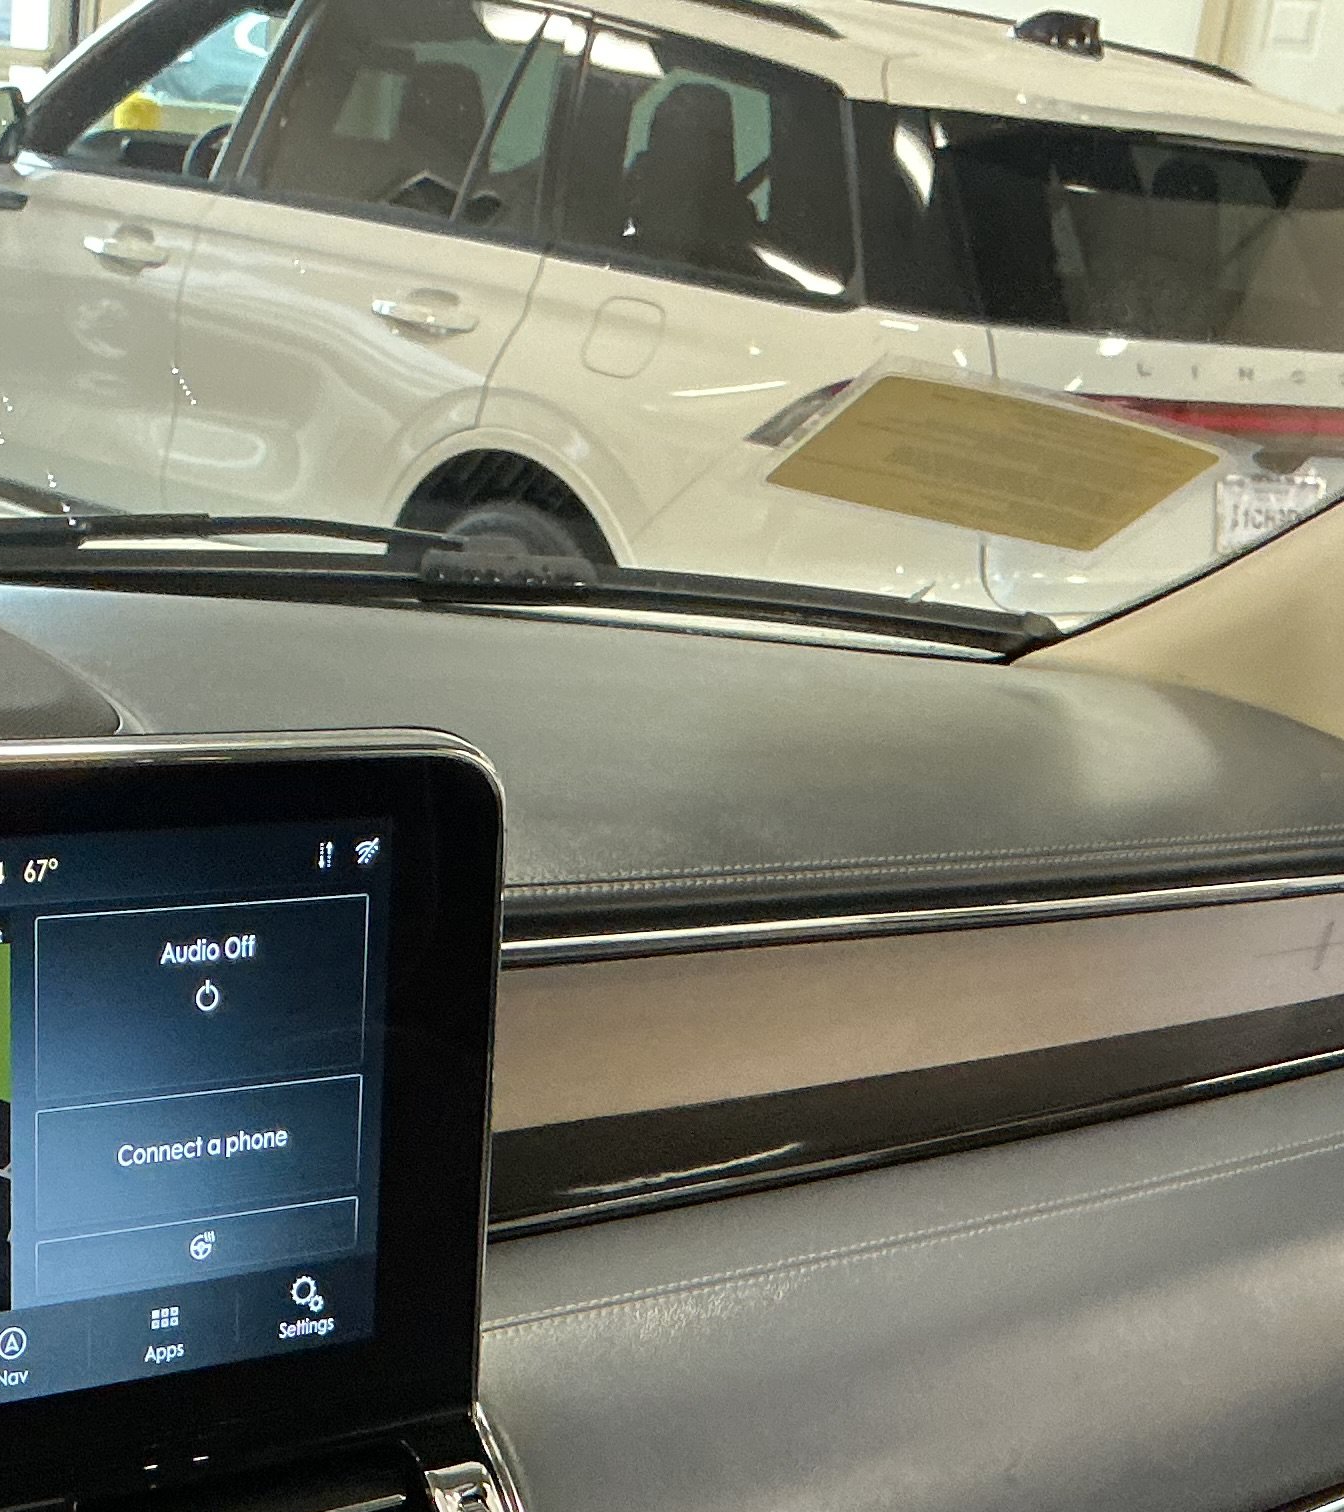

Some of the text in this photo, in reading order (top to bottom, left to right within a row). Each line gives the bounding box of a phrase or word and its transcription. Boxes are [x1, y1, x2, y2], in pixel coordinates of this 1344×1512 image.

[23, 857, 59, 883] 67°
[159, 935, 256, 966] Audio Off
[117, 1128, 288, 1168] Connect a phone
[278, 1315, 335, 1340] Settings
[144, 1342, 185, 1364] Apps
